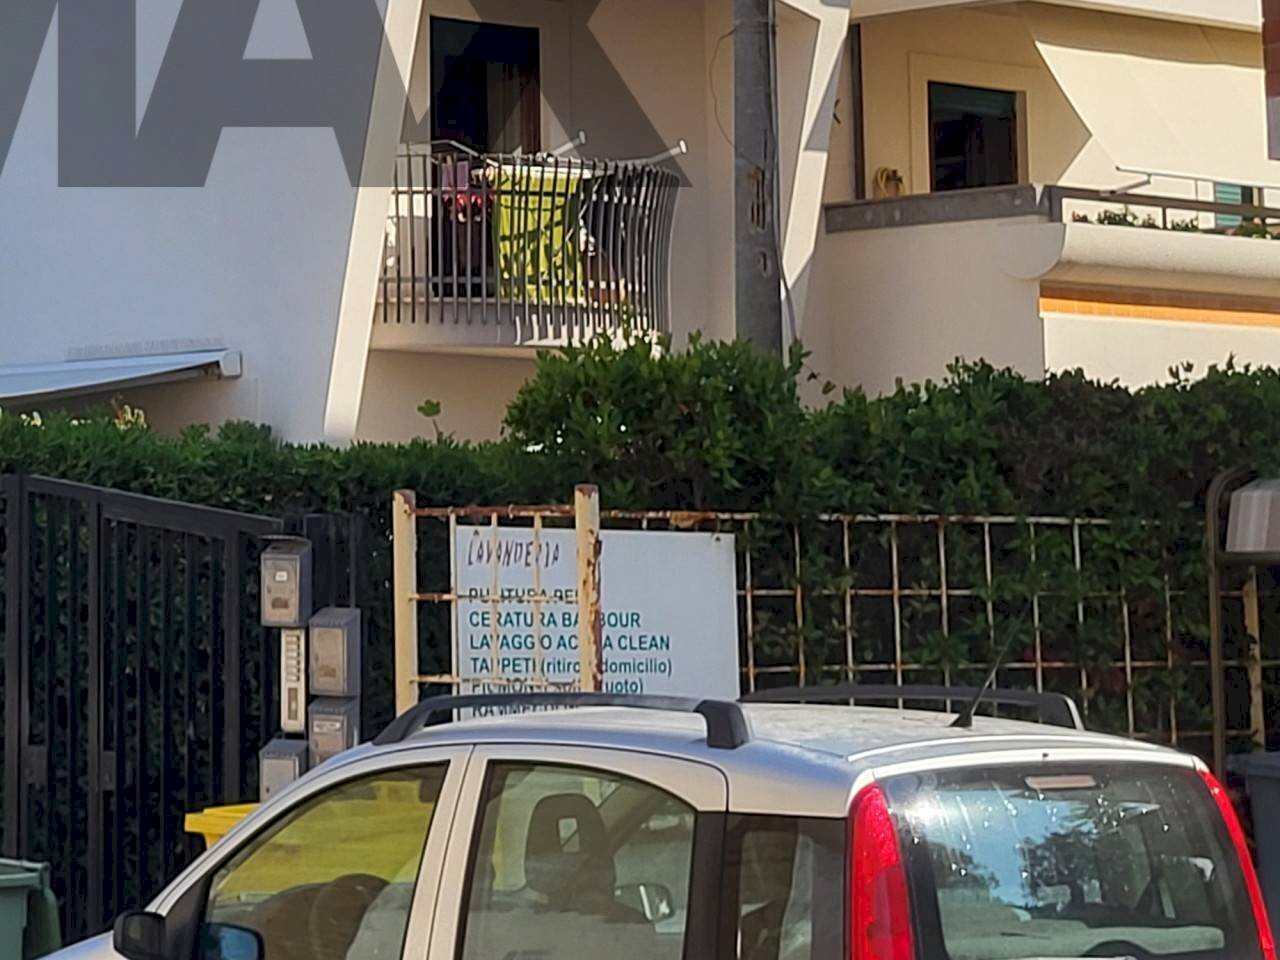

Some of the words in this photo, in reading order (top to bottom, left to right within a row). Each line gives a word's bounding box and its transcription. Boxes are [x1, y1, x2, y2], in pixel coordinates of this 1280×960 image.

[468, 587, 550, 604] PUITURA
[469, 634, 552, 651] LAAGGO
[556, 634, 614, 651] ACA
[617, 634, 670, 651] CLEAN
